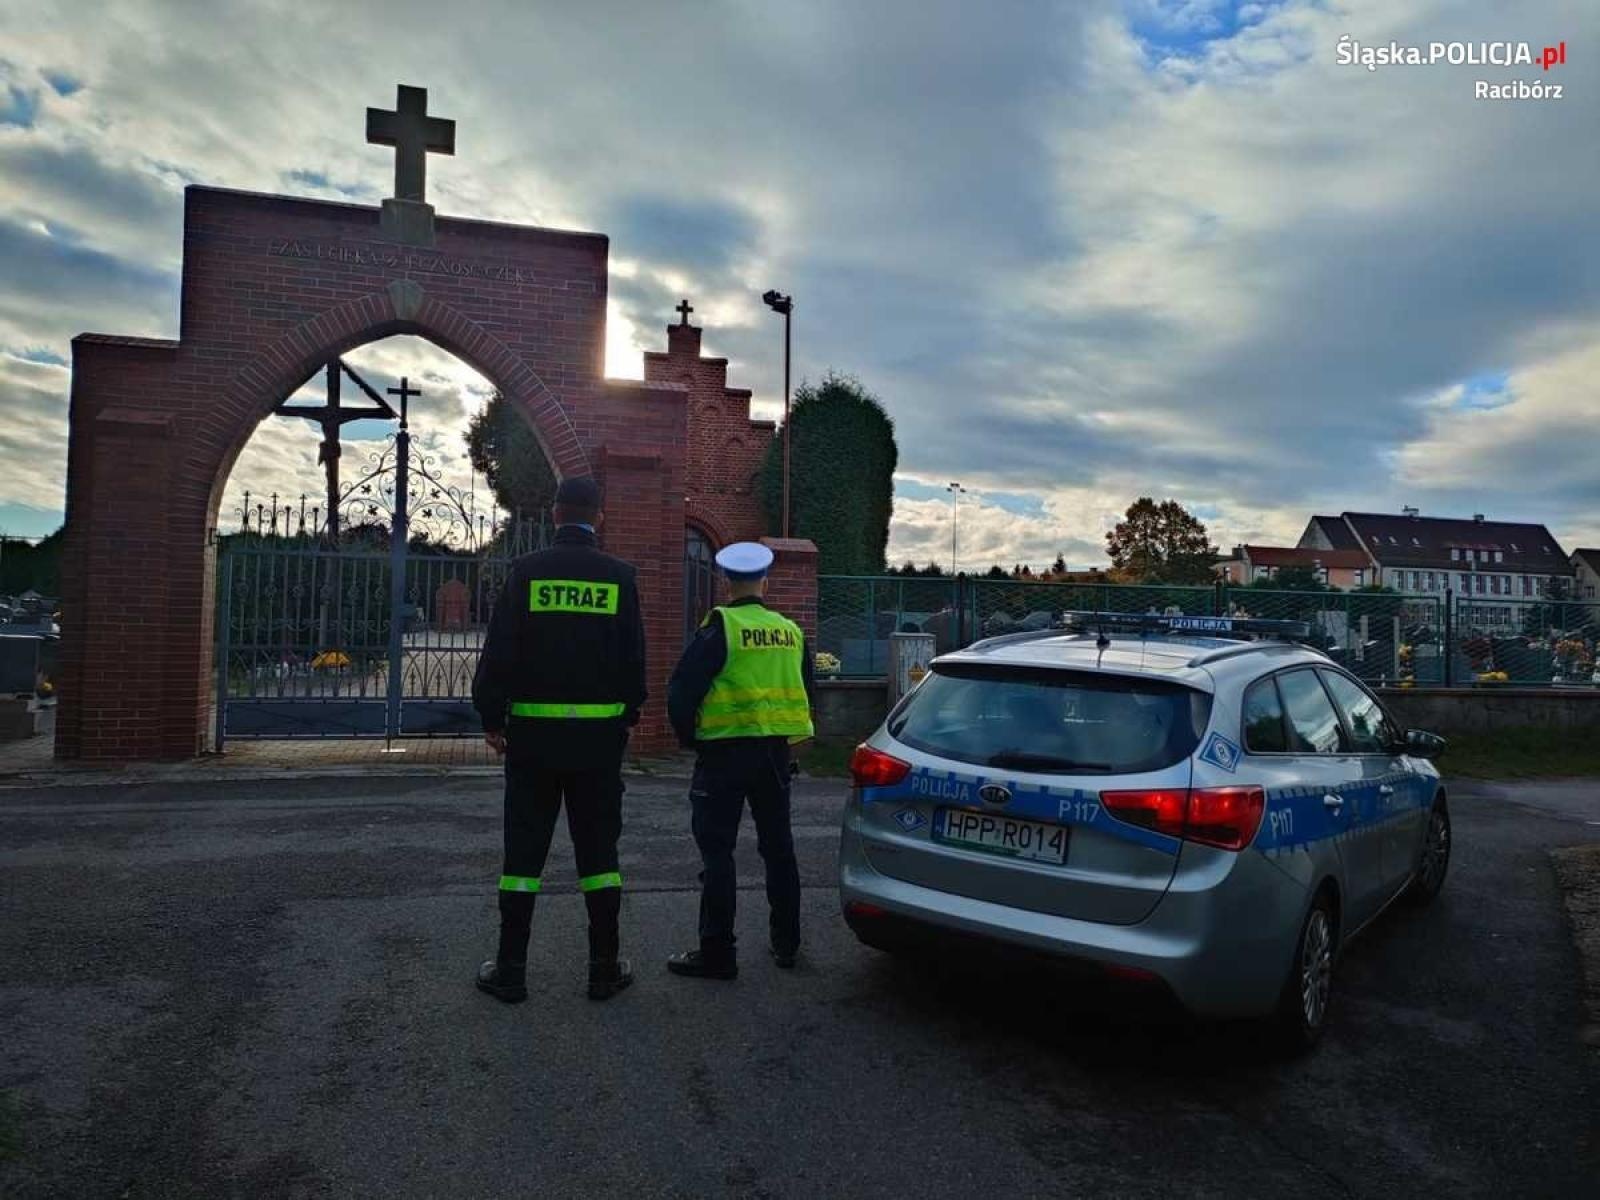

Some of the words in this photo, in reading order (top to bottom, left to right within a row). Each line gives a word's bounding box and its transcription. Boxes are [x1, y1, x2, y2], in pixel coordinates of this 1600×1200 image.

[741, 628, 796, 648] POLICJA
[911, 776, 969, 801] POLICJA
[946, 811, 995, 842] HPP
[1002, 821, 1064, 855] R014
[1270, 808, 1294, 840] P117
